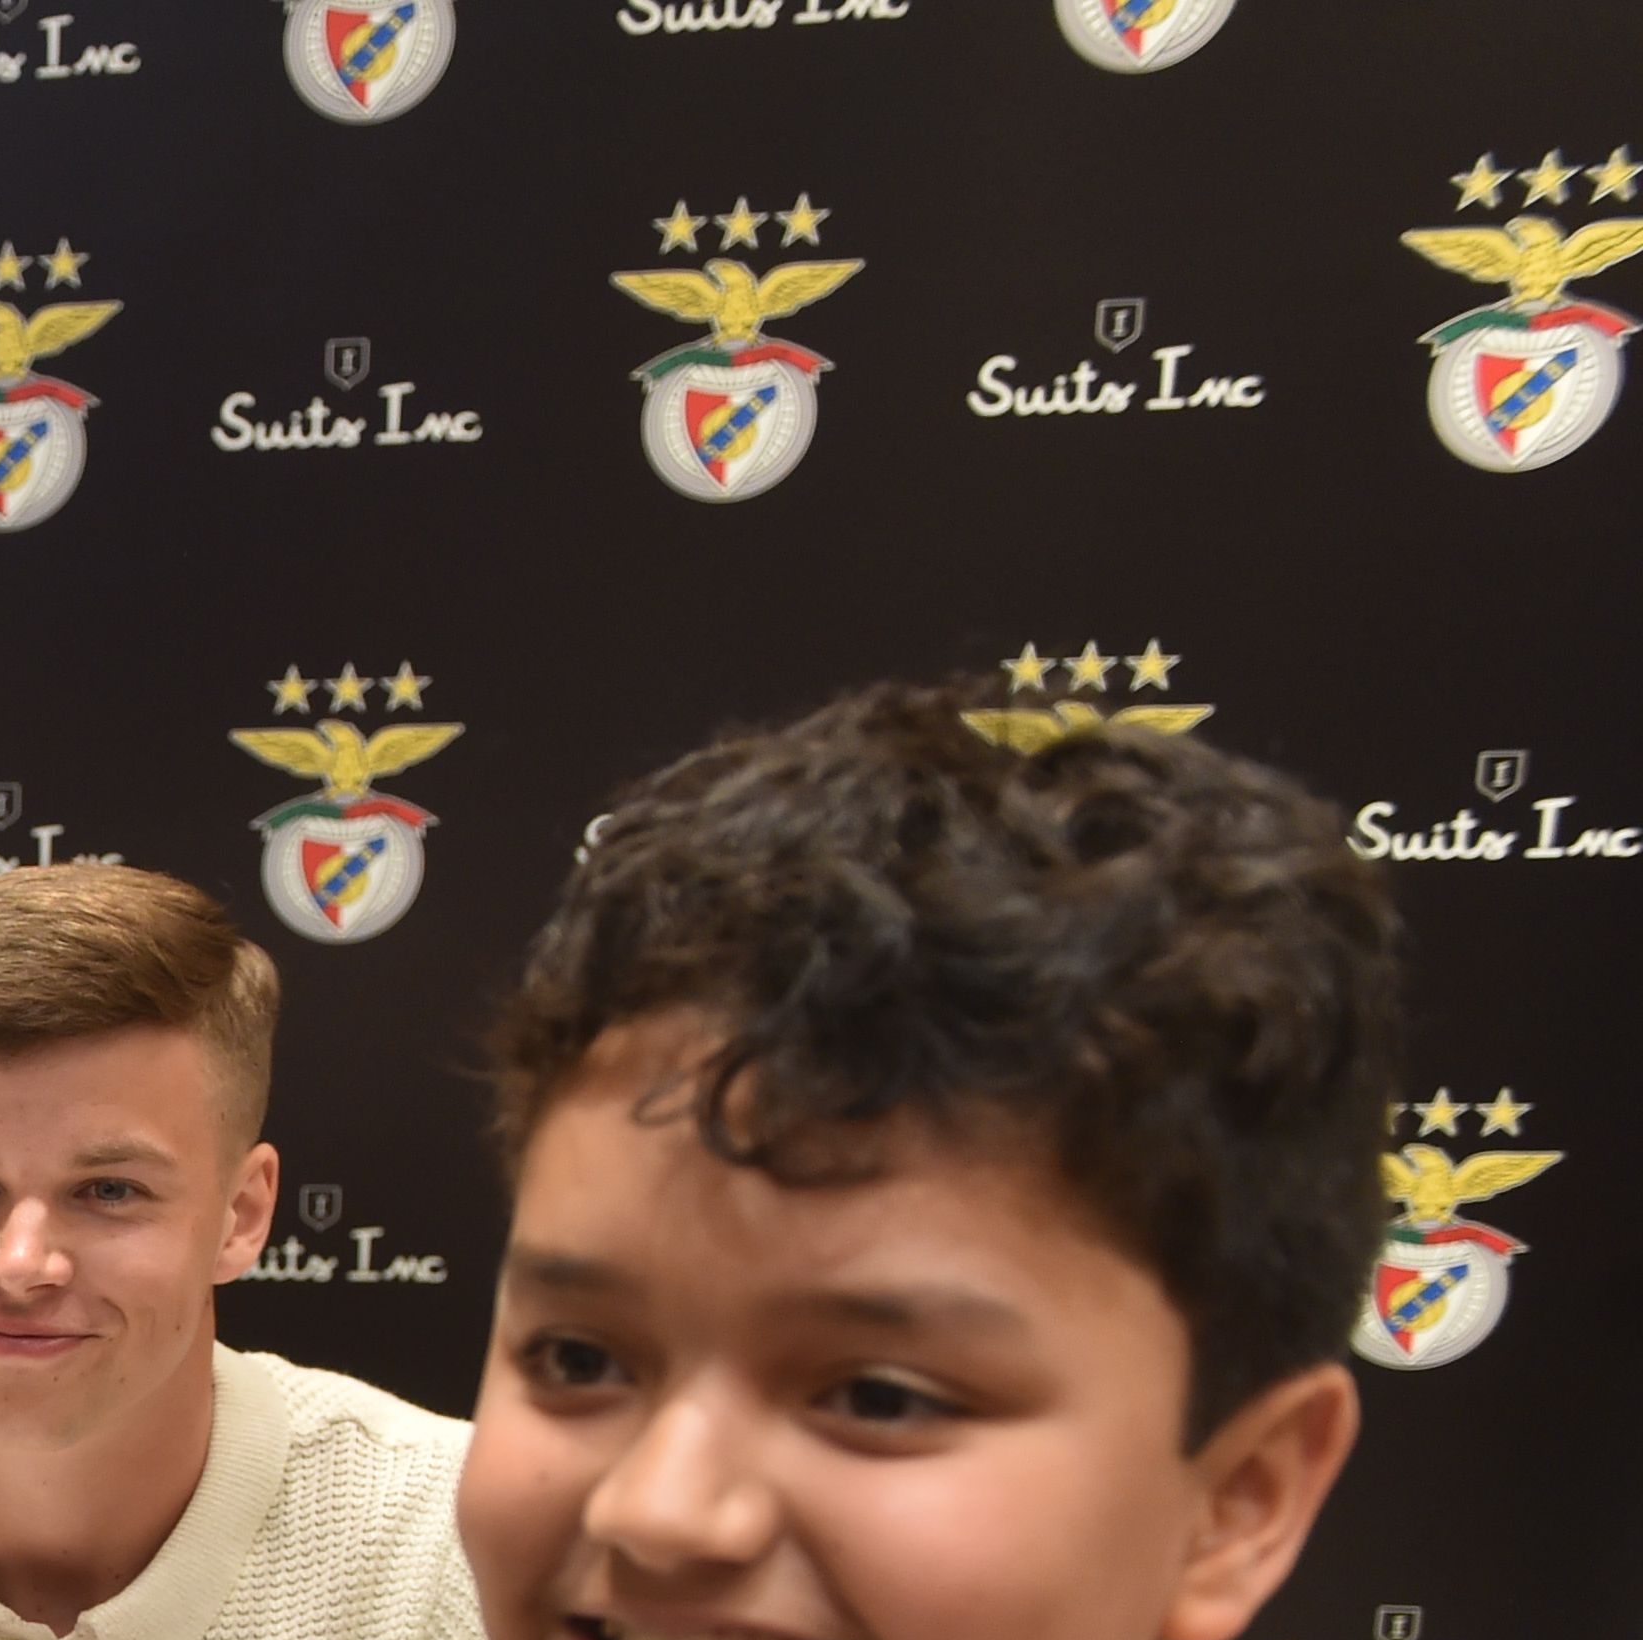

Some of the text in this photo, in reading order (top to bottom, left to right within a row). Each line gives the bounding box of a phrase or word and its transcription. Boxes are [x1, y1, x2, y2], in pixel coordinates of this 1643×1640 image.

[37, 14, 141, 79] Inc
[967, 344, 1266, 417] Suits Inc
[211, 381, 483, 451] Suits Inc
[1346, 796, 1643, 861] Suits Inc
[346, 1225, 448, 1284] Inc
